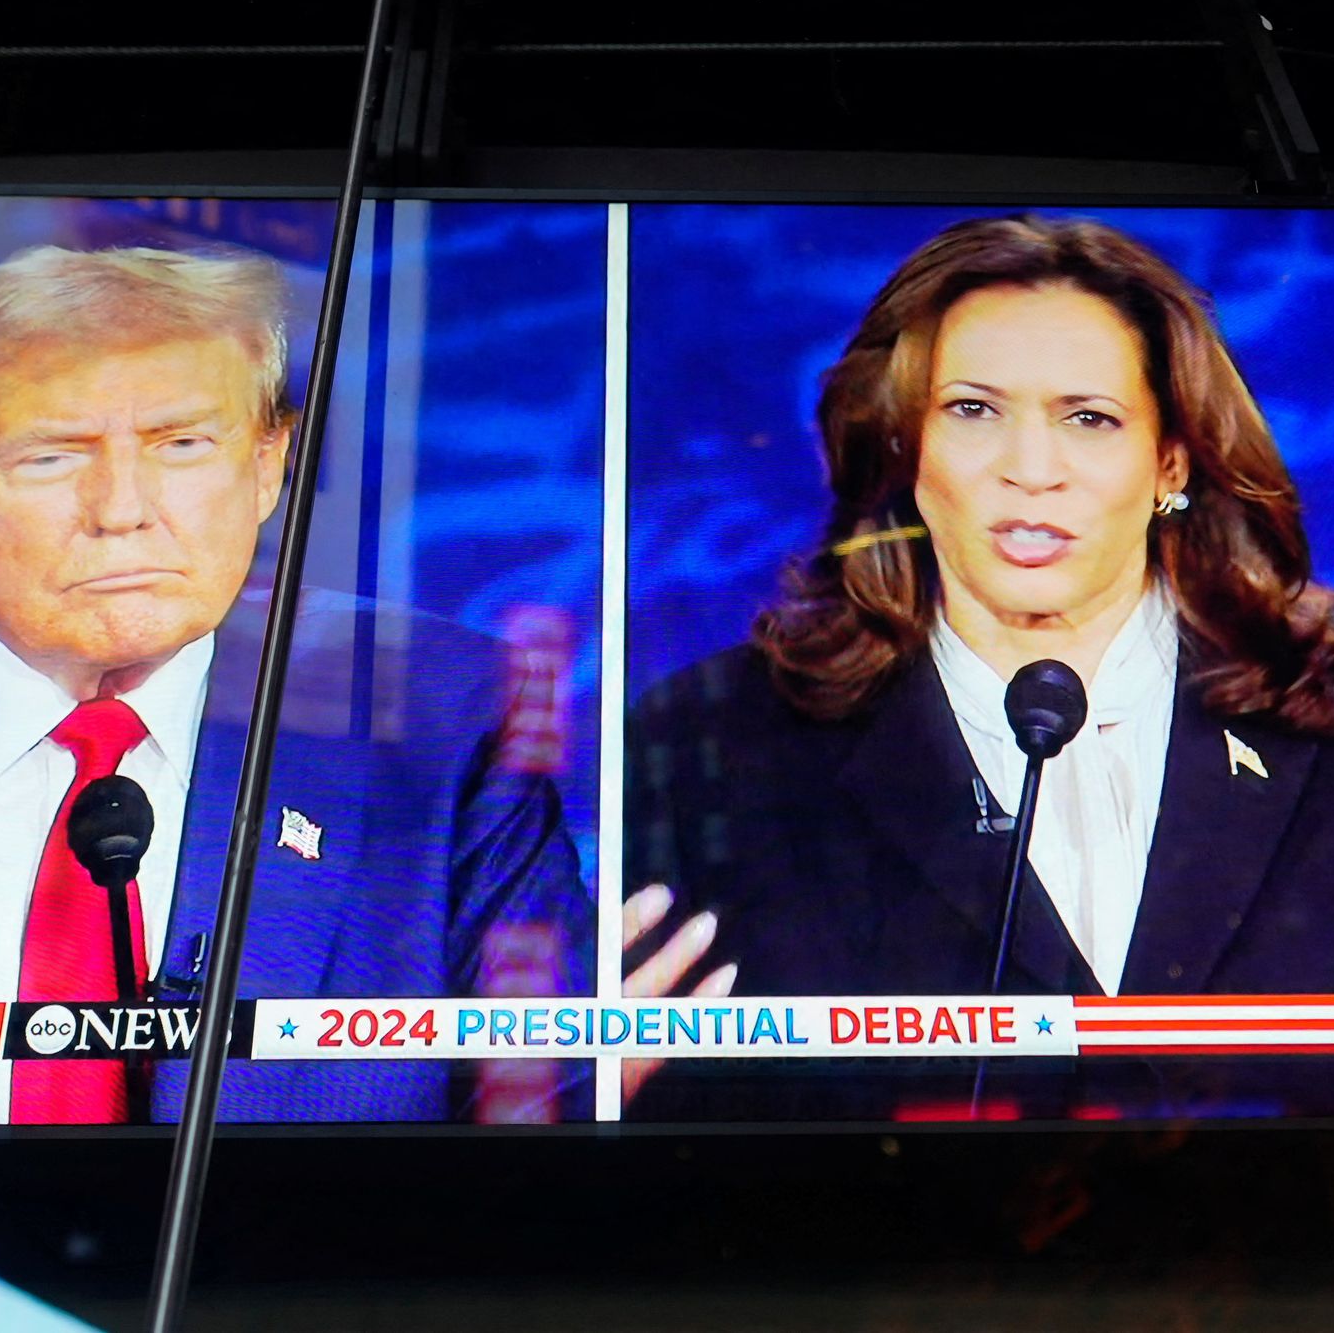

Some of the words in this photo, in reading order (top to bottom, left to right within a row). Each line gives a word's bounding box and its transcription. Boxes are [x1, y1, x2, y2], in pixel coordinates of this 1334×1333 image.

[29, 1019, 72, 1039] abc
[74, 1006, 233, 1052] NEW
[316, 1008, 439, 1048] 2024
[457, 1007, 809, 1046] PRESIDENTIAL
[829, 1006, 1018, 1044] DEBATE
